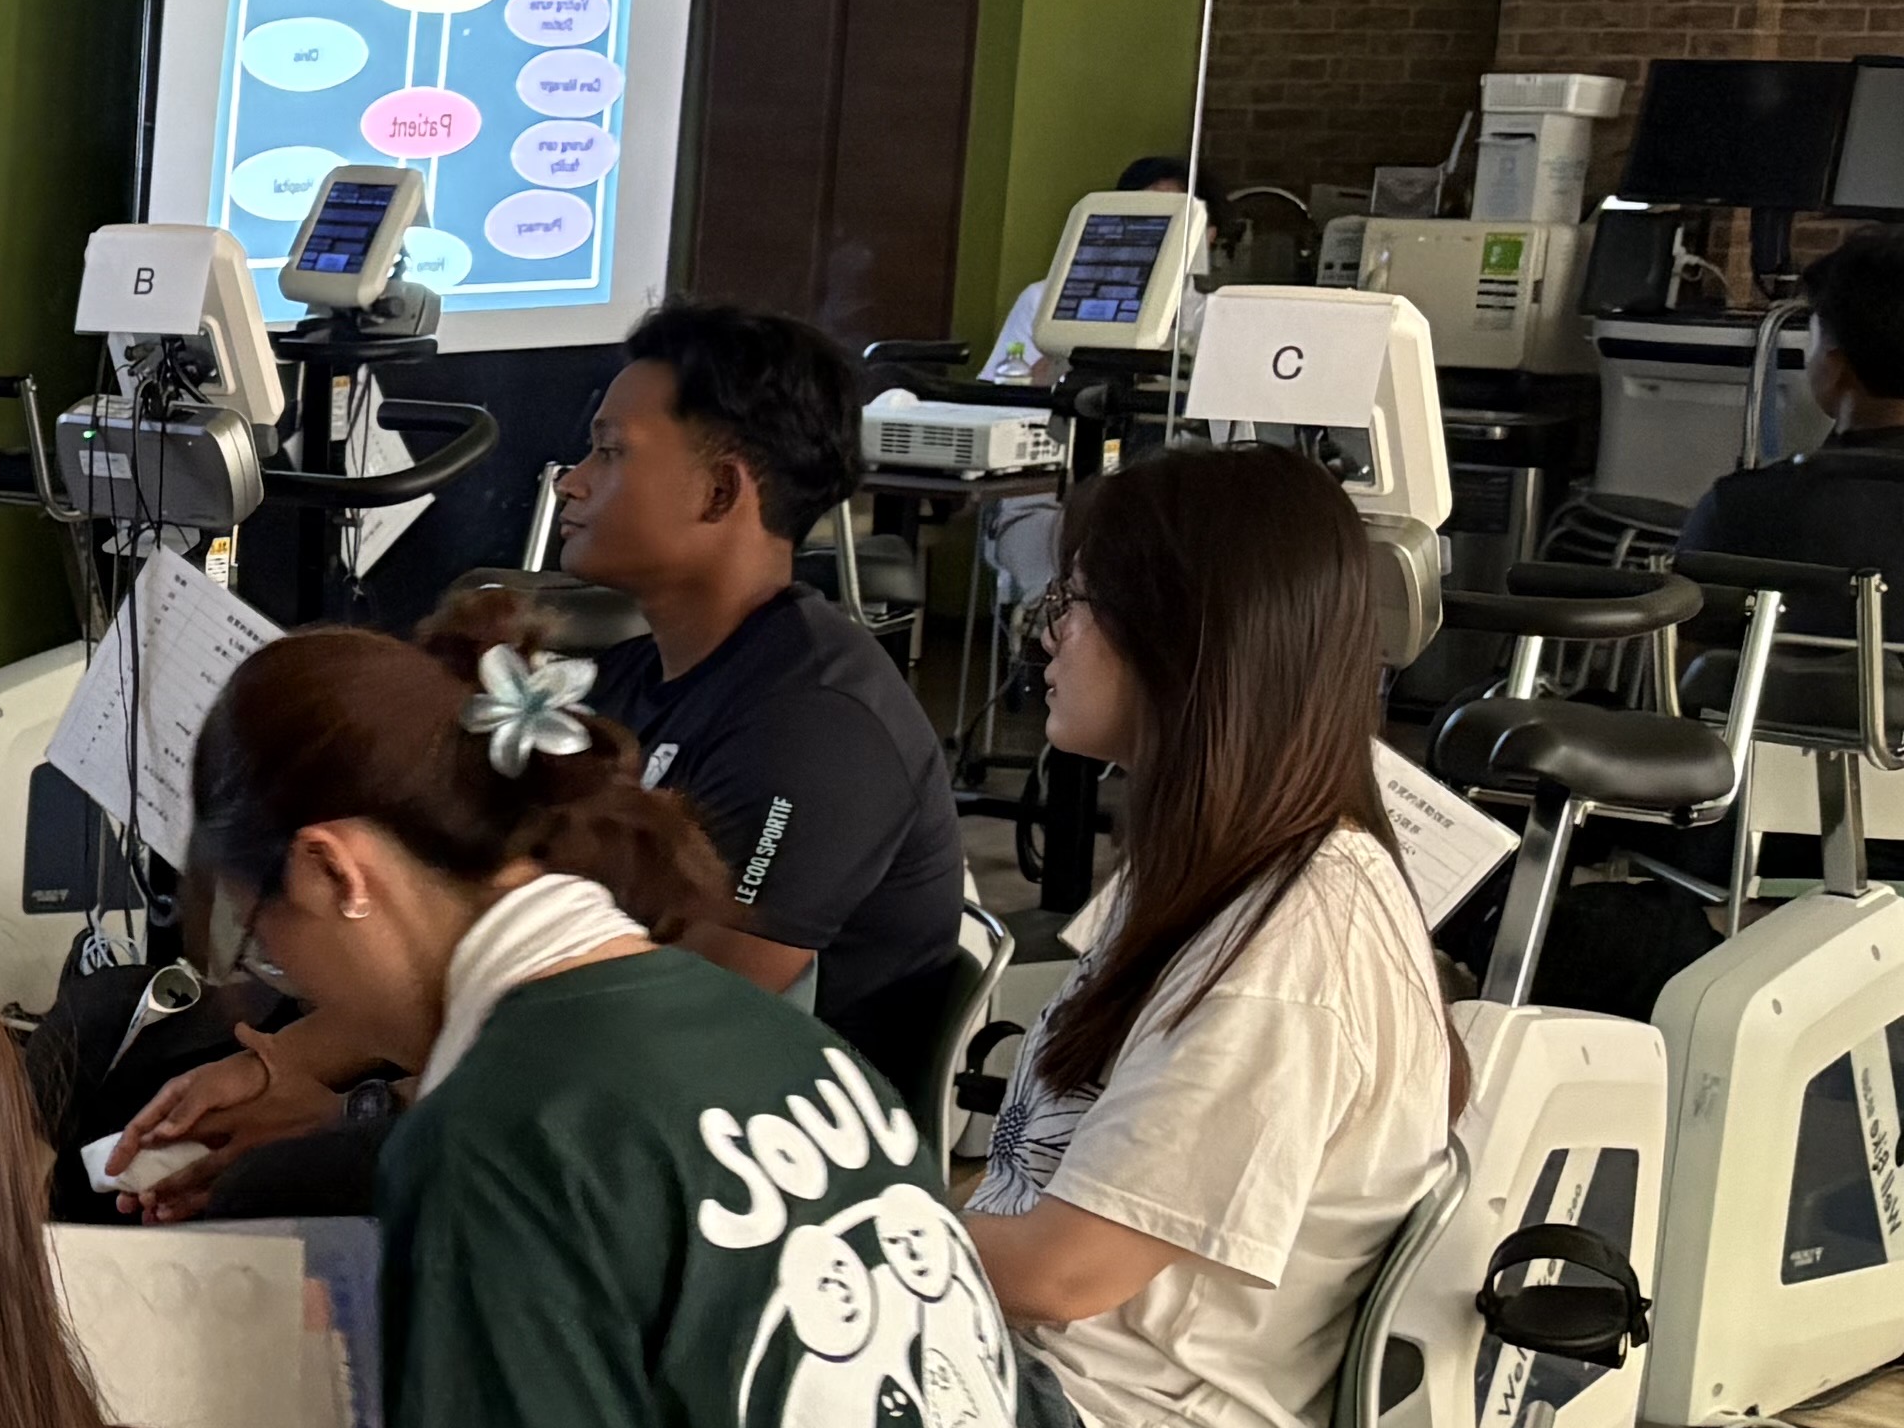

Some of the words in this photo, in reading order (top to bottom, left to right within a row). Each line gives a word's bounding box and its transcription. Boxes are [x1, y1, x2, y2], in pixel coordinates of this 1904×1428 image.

[133, 266, 155, 295] B
[1271, 345, 1304, 381] C
[755, 795, 793, 857] SPORTIF
[742, 856, 771, 886] COQ
[734, 884, 758, 905] LE
